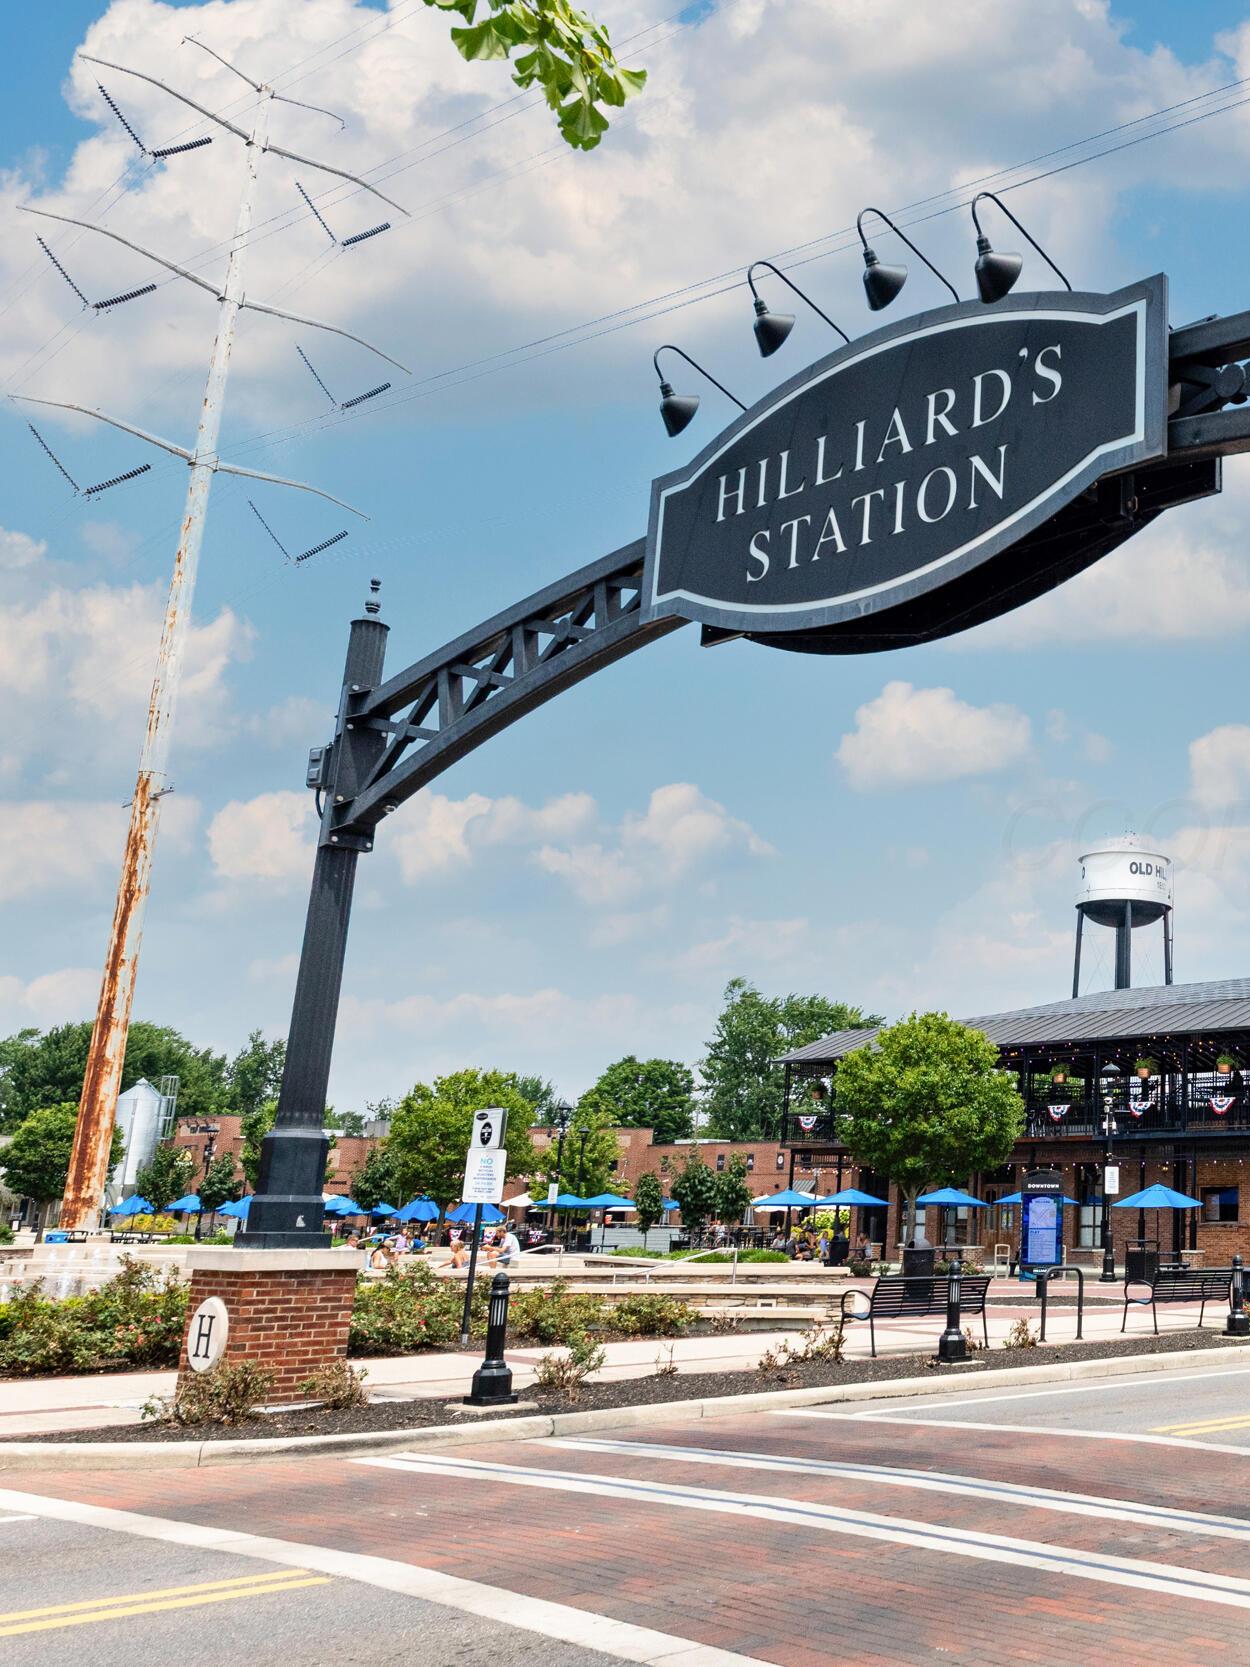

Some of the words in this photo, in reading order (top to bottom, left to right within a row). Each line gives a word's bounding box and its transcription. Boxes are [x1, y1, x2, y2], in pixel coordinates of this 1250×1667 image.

[715, 343, 1063, 523] HILLIARD'S
[746, 444, 1010, 583] STATION
[1129, 861, 1153, 876] OLD
[193, 1313, 217, 1360] H
